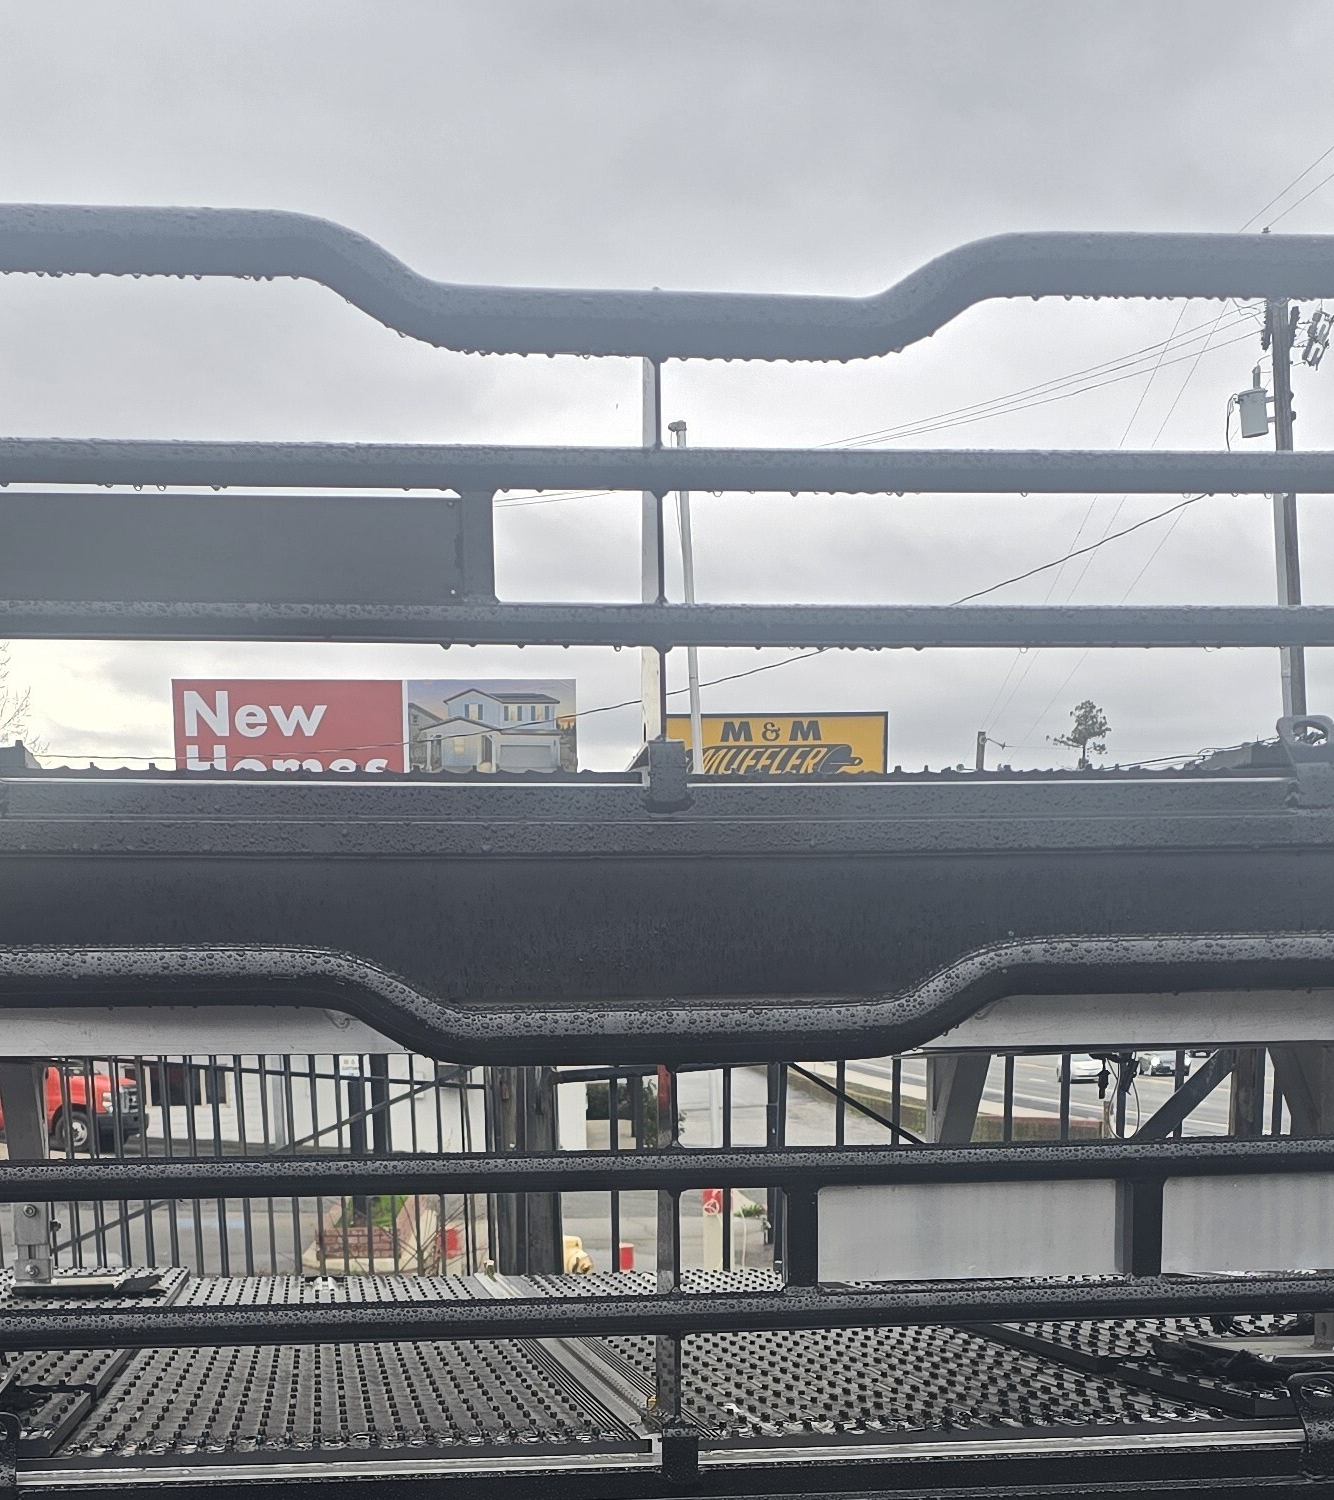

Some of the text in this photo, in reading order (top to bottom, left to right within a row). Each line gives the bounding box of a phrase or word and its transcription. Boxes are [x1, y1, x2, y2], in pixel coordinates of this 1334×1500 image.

[183, 690, 328, 738] New
[720, 720, 822, 742] M & M
